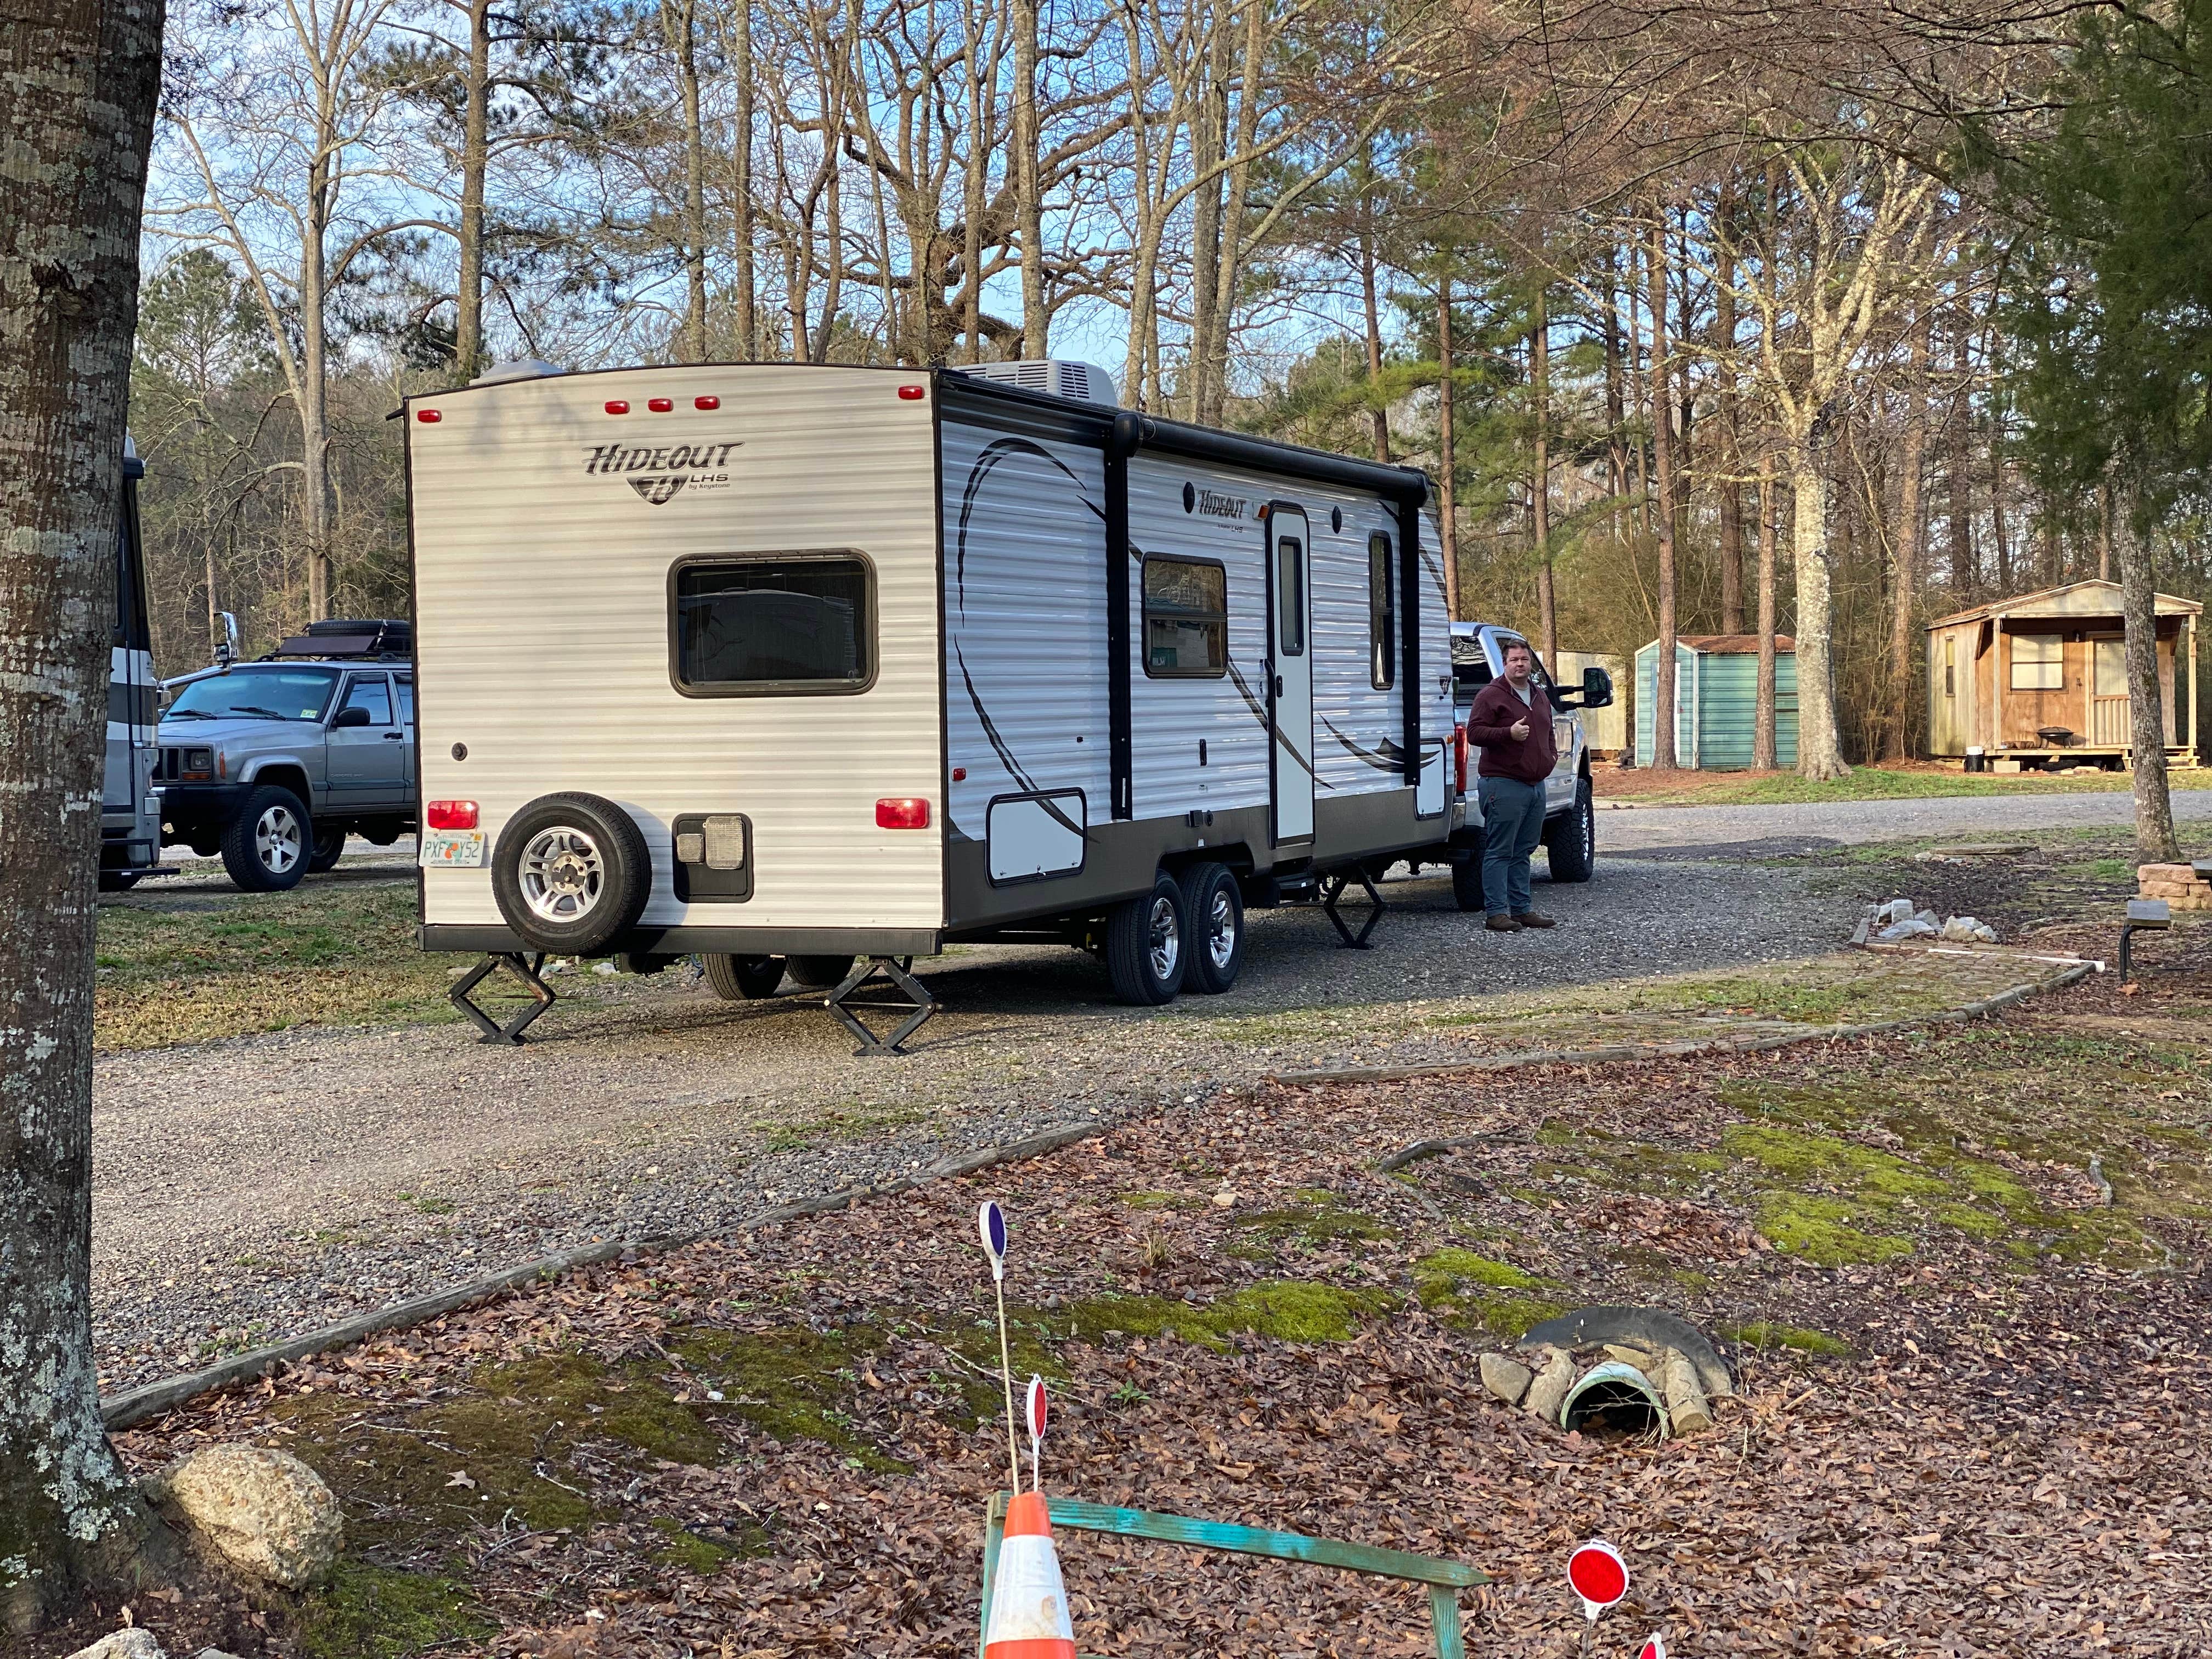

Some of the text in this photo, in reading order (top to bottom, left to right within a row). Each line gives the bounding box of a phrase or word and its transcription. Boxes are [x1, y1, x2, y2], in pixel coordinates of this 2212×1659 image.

[582, 441, 746, 476] HIDEOUT
[690, 473, 729, 483] LHS
[1198, 489, 1247, 520] HIDEOUT
[1231, 525, 1243, 533] LHS
[424, 841, 479, 857] PXF Y52
